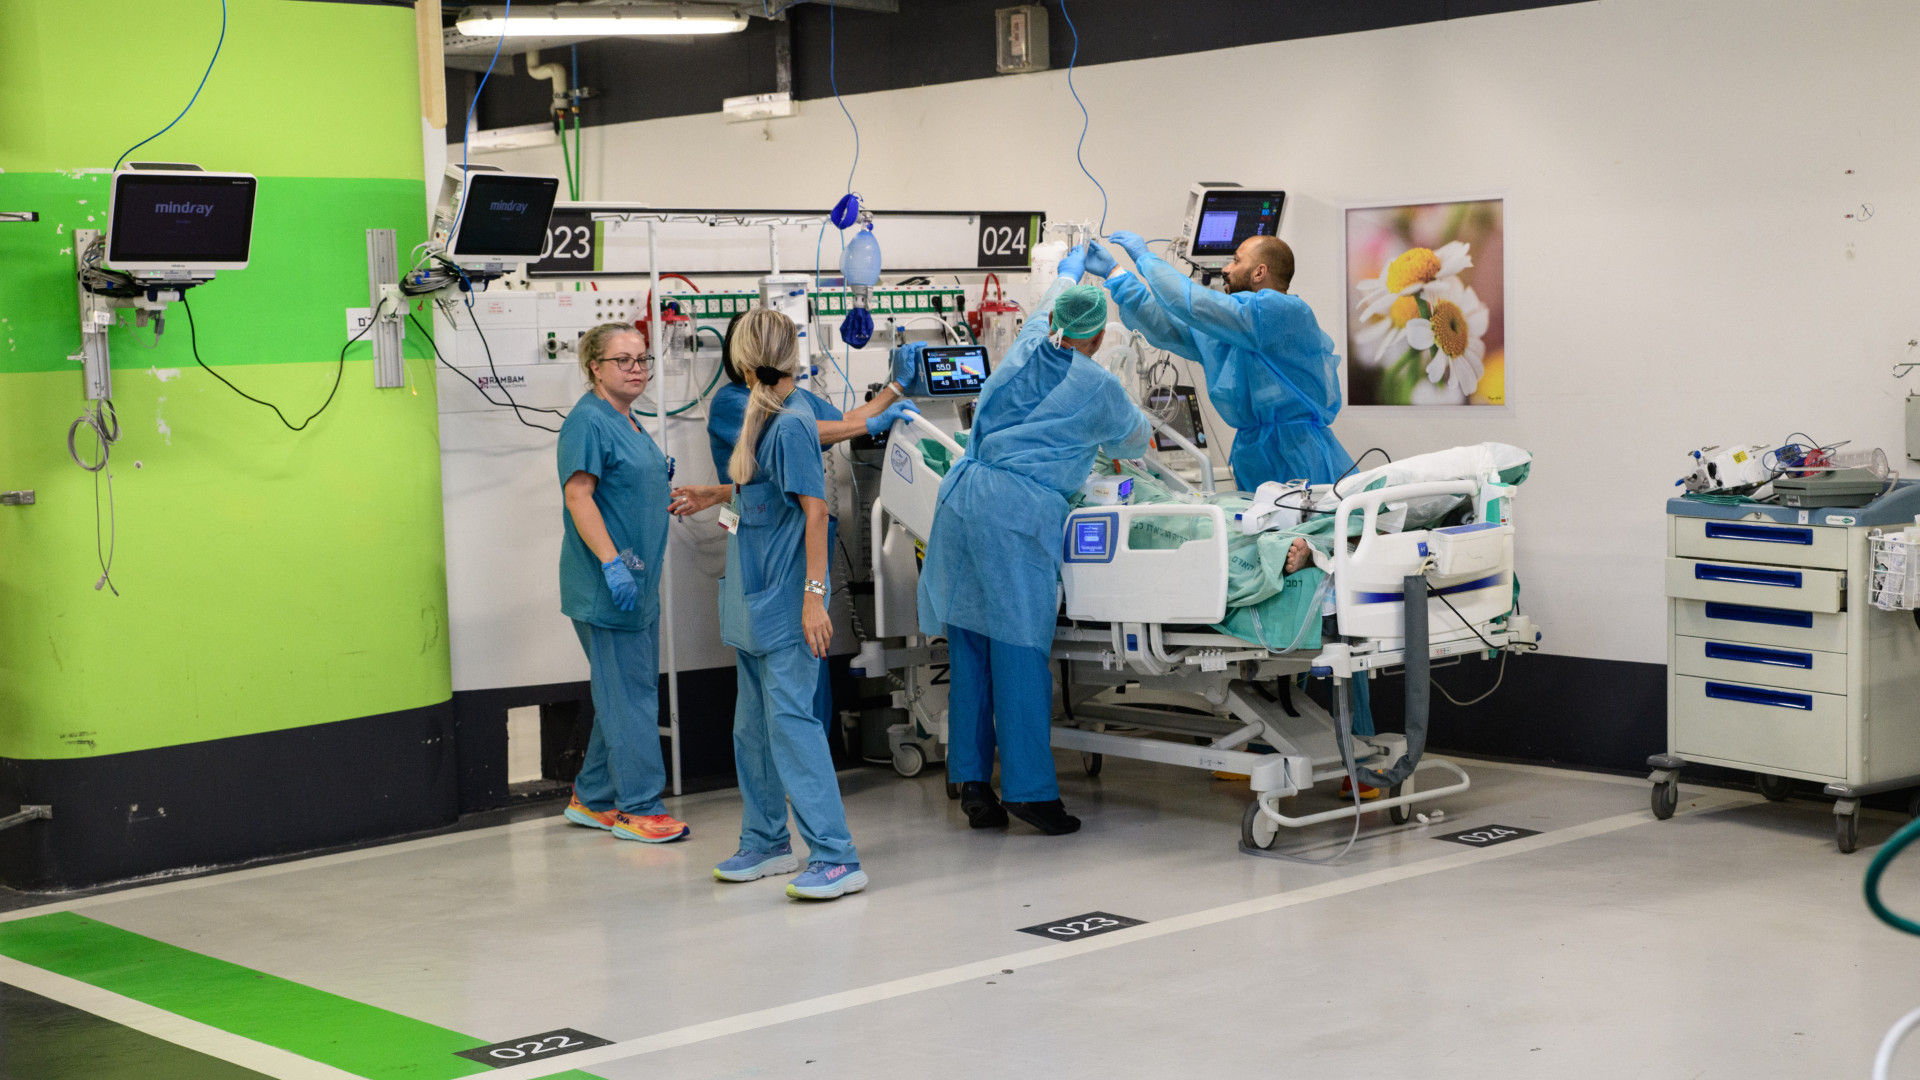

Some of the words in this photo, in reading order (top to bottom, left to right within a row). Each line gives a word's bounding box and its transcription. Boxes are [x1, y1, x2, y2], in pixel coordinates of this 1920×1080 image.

[155, 201, 213, 217] mindray
[490, 200, 528, 214] mindray
[982, 226, 1027, 256] 024
[1457, 828, 1519, 843] 024
[825, 864, 847, 881] HOKA
[1047, 916, 1119, 936] 023
[489, 1035, 584, 1060] 022
